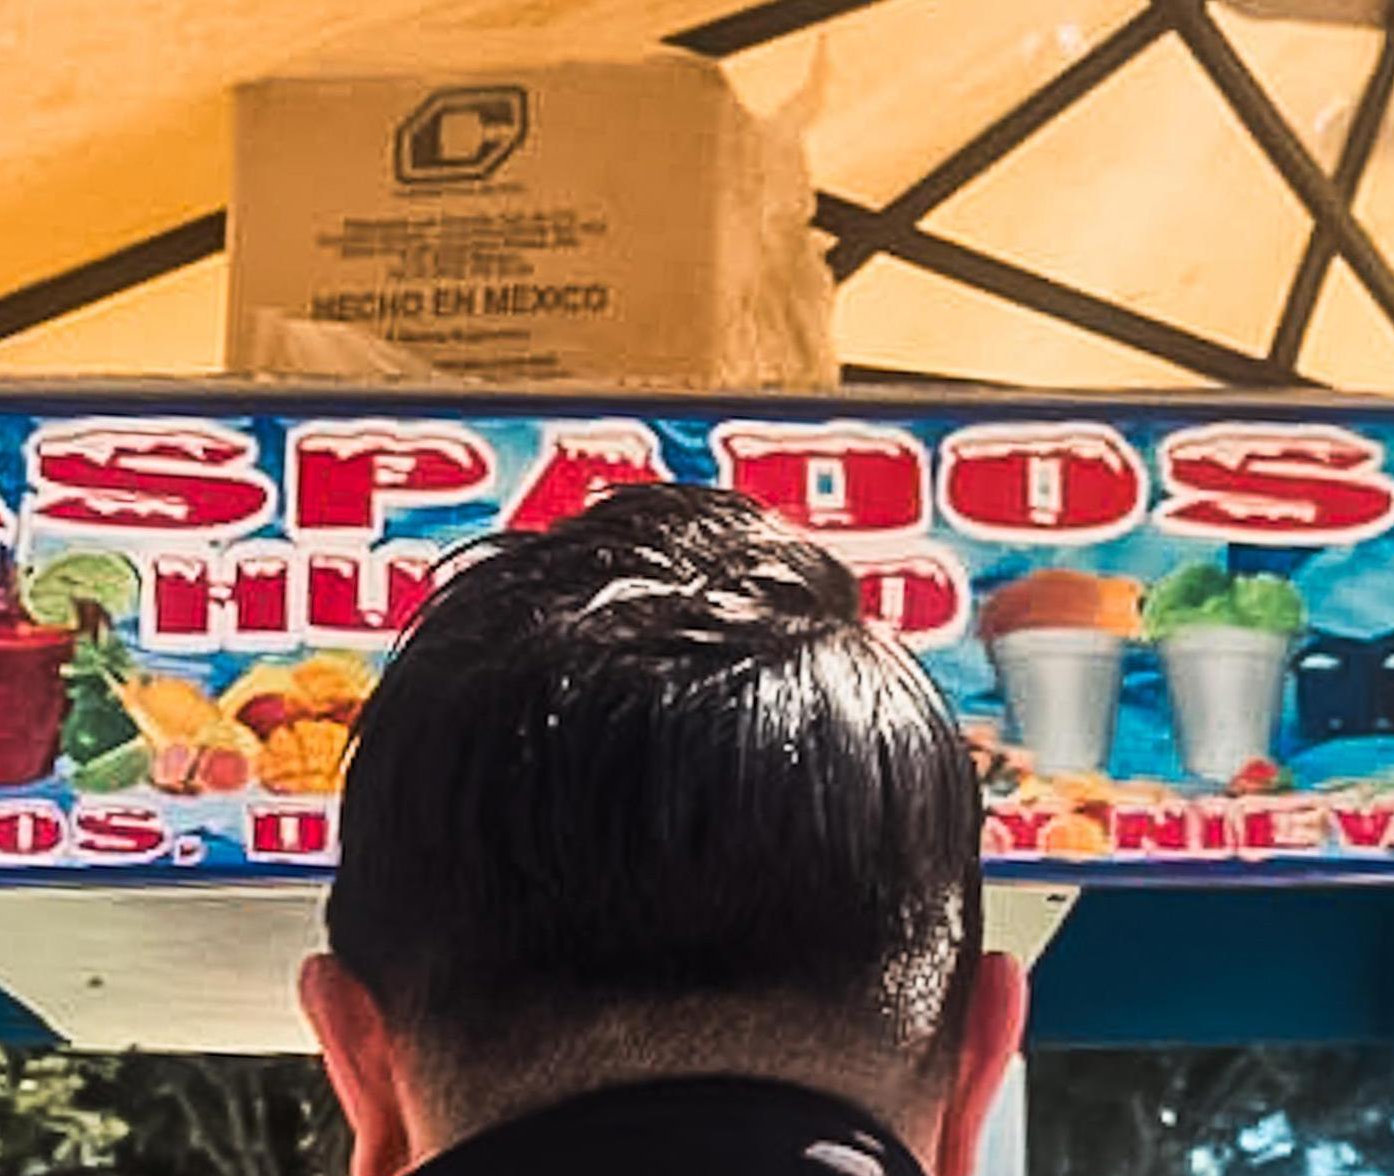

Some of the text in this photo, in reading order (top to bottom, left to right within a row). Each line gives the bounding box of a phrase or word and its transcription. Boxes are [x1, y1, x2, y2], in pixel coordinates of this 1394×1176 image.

[311, 281, 608, 322] HECHO EN MEXICO
